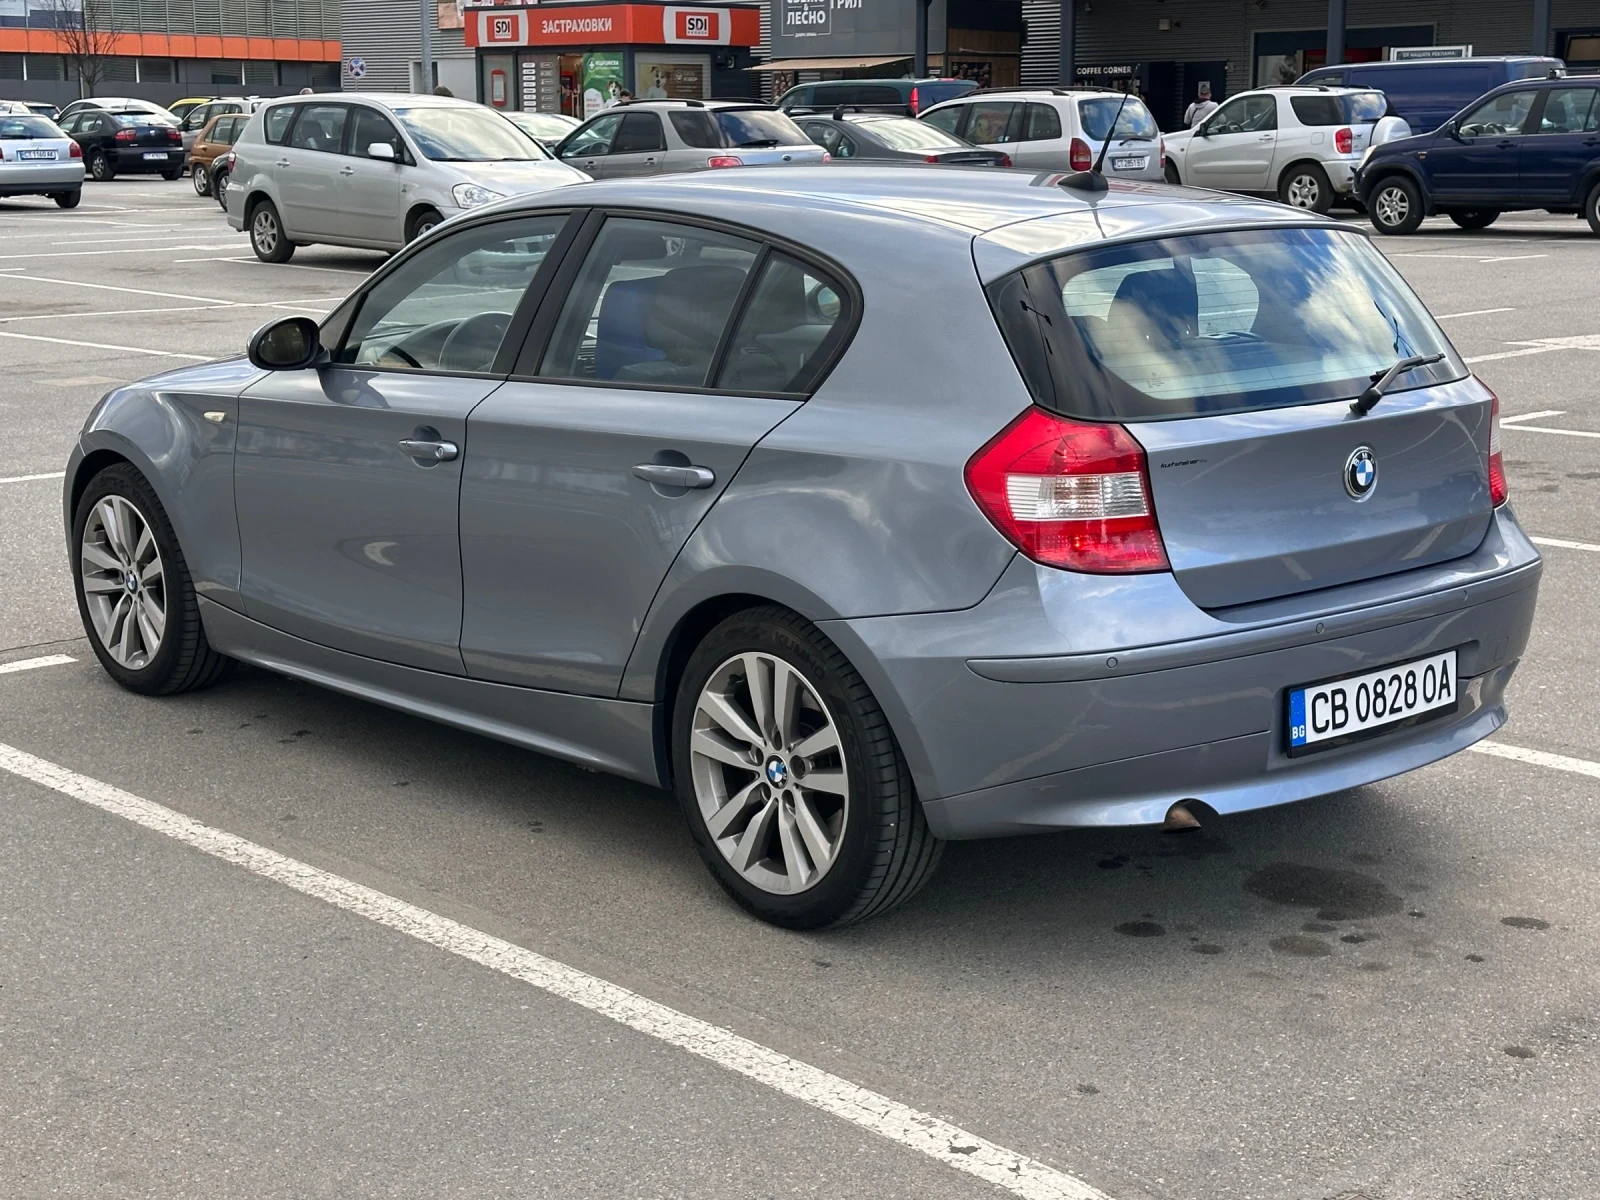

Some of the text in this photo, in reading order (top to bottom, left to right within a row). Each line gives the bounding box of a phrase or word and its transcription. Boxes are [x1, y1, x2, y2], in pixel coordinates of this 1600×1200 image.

[687, 18, 707, 31] SDI
[786, 10, 826, 25] ЛЕСНО
[495, 21, 511, 34] SDI
[541, 17, 612, 34] ЗАСТРАХОВКИ
[1076, 65, 1132, 75] COFFEE CORNER
[1311, 659, 1452, 734] CB 0828 OA
[1292, 725, 1305, 740] BG
